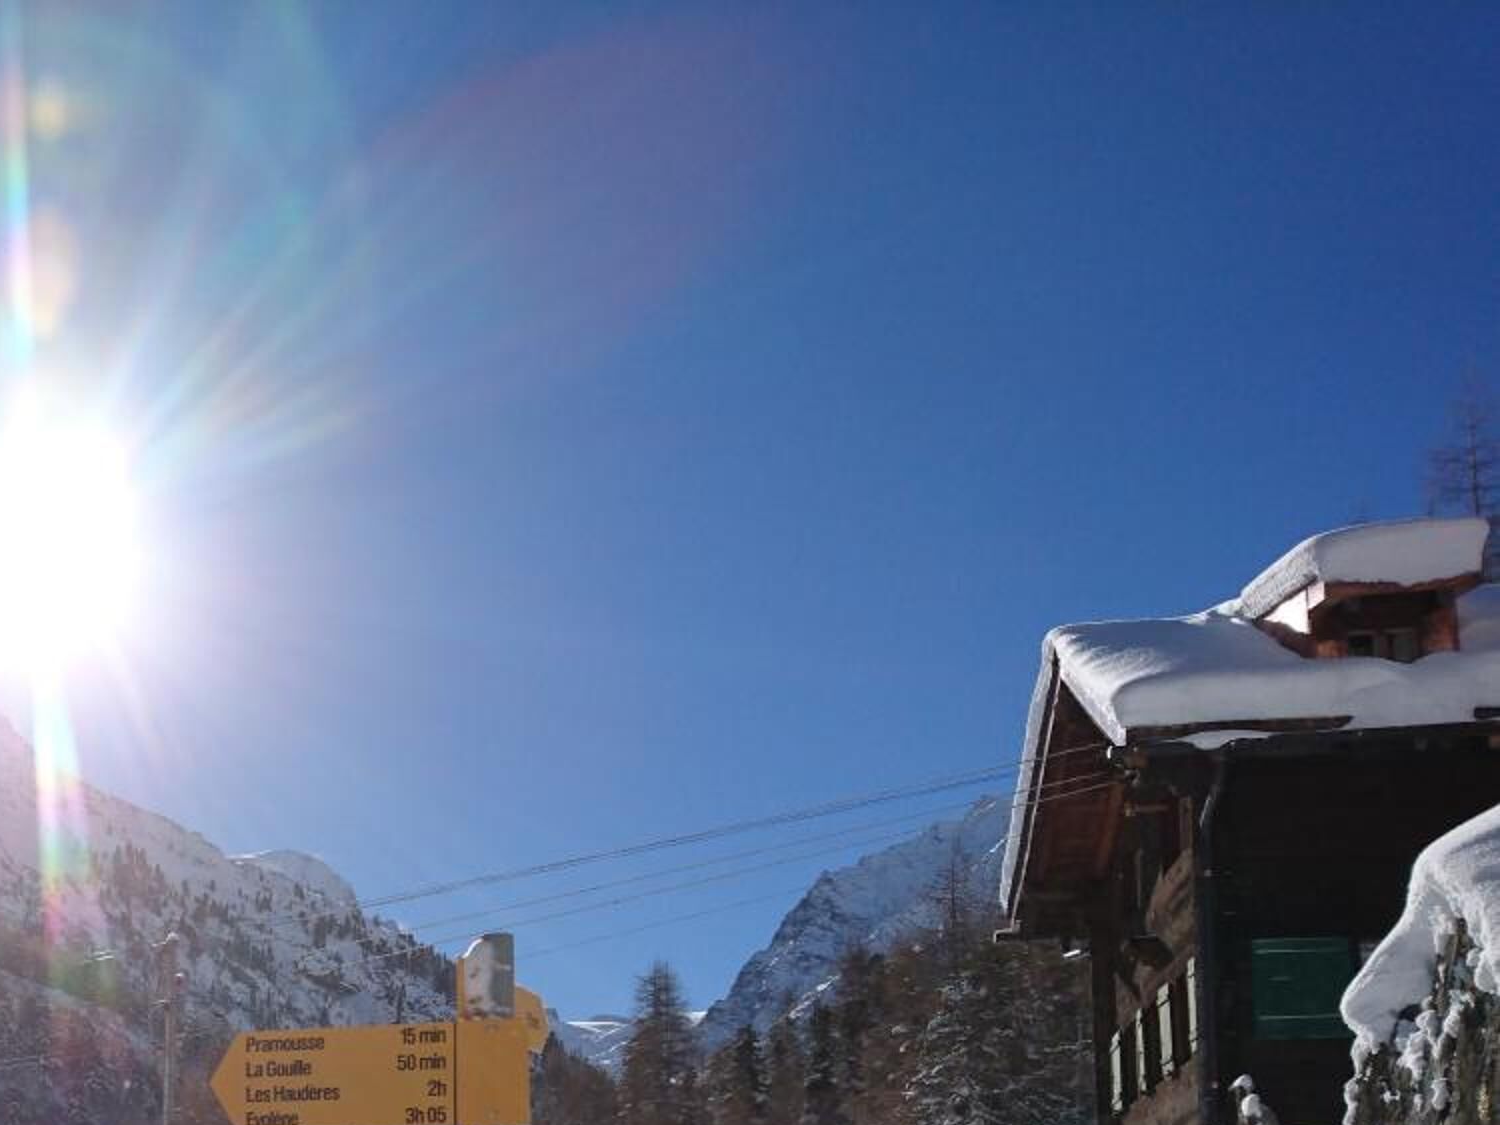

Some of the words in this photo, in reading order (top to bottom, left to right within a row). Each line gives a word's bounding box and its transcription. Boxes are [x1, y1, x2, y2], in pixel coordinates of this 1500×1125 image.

[245, 1036, 325, 1052] Pramousse
[401, 1027, 416, 1045] 15
[419, 1027, 447, 1044] min
[245, 1062, 264, 1077] La
[266, 1059, 312, 1077] Gouille
[397, 1054, 416, 1071] 50
[419, 1052, 447, 1070] min
[245, 1086, 271, 1103] Les
